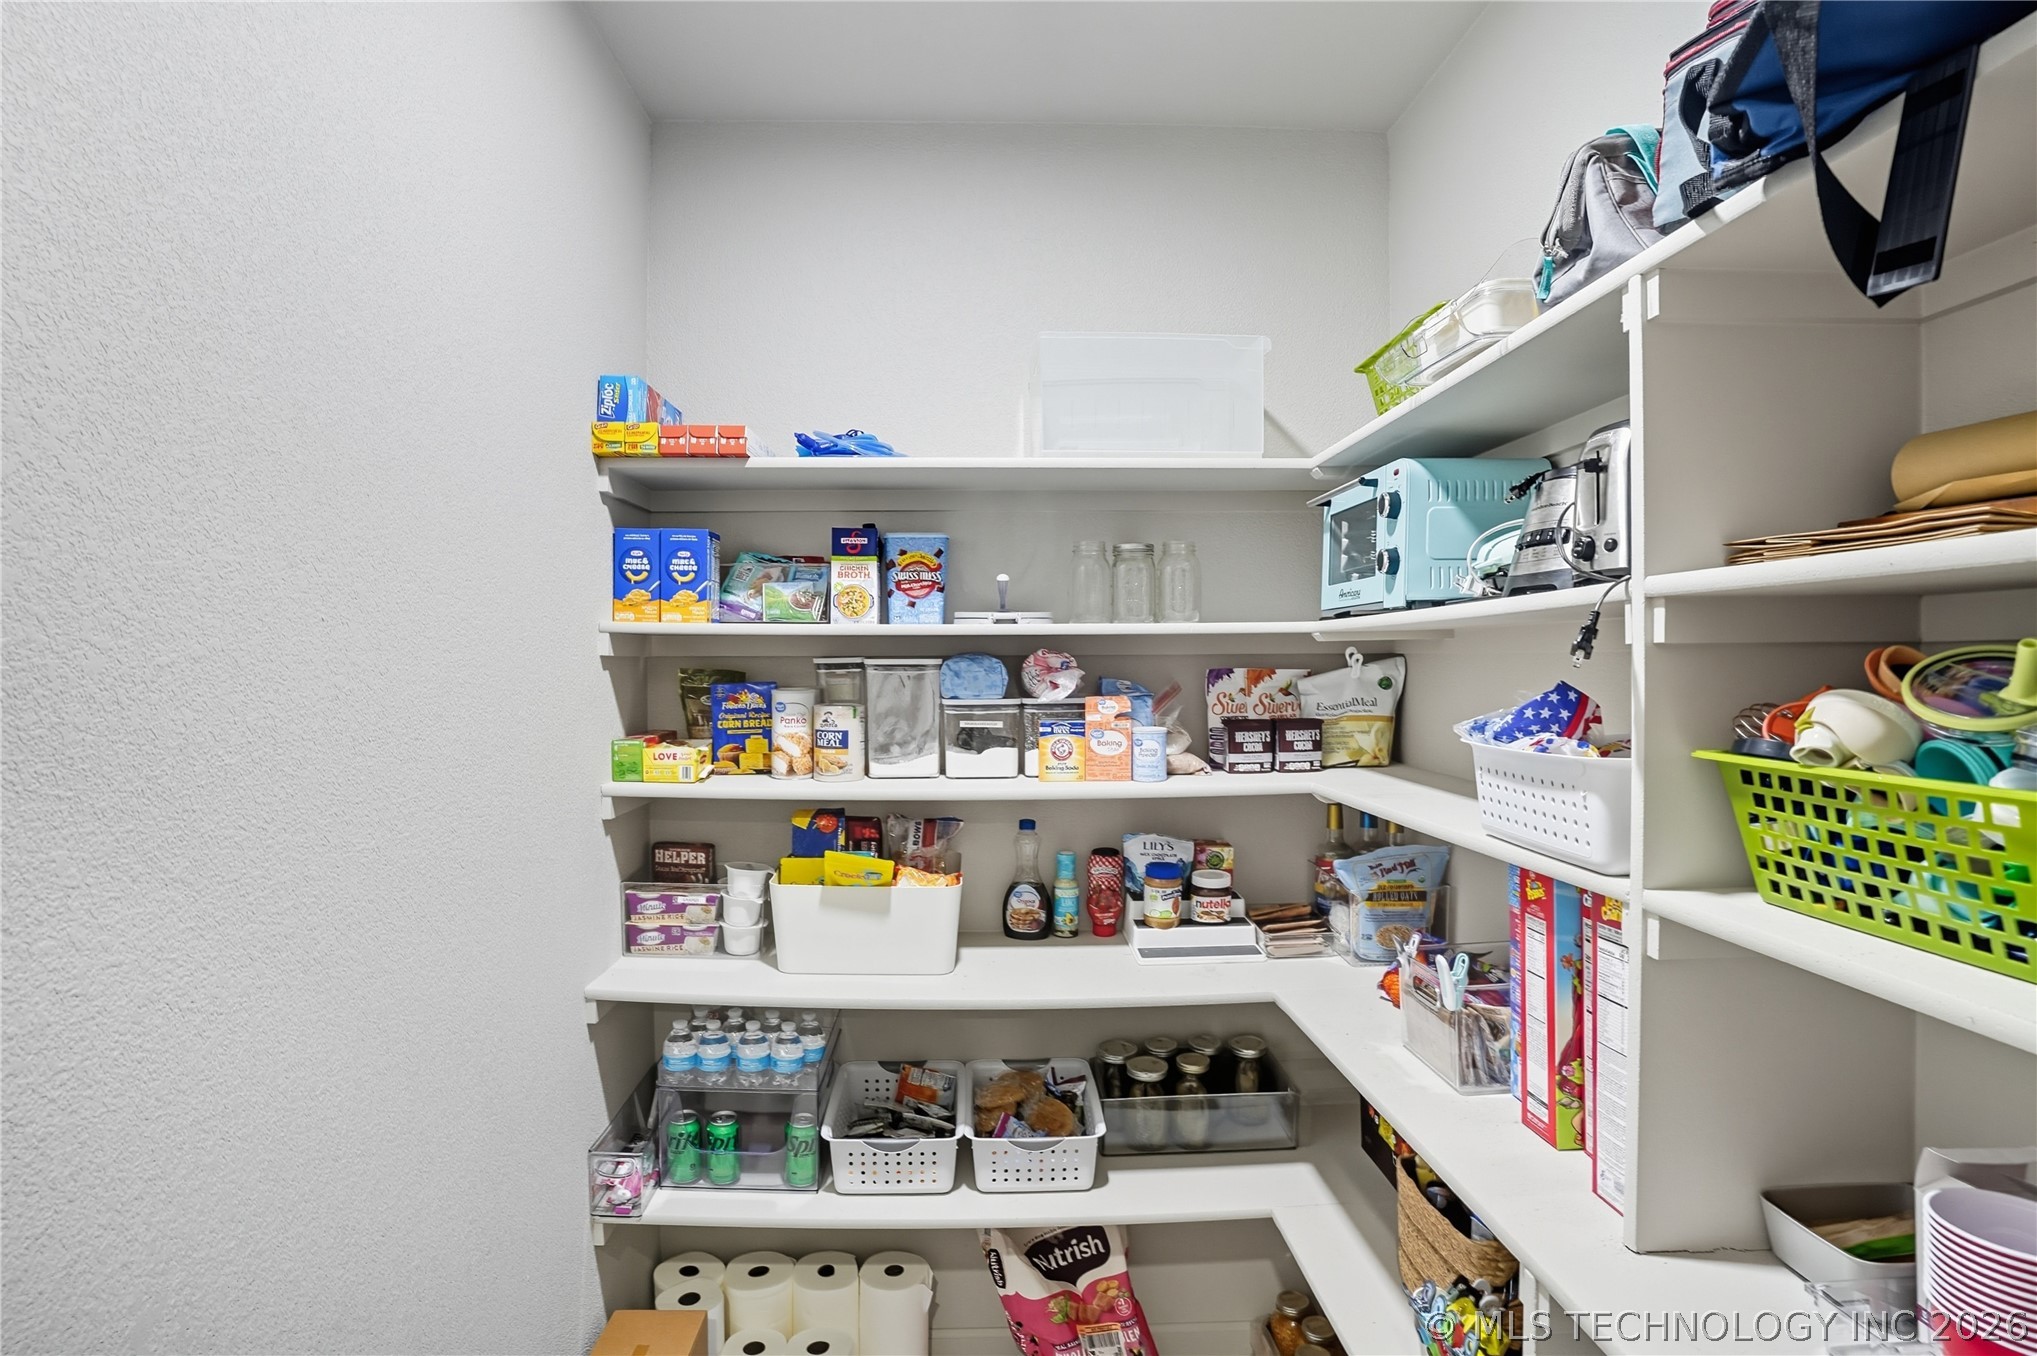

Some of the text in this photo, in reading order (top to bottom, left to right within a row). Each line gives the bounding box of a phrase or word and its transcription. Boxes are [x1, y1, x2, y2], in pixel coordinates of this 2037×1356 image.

[600, 383, 616, 416] Ziploc
[837, 571, 871, 579] BROTH
[817, 731, 843, 740] CORN
[817, 739, 843, 747] MEAL
[1097, 740, 1123, 748] Baking
[653, 752, 678, 760] LOVE
[911, 820, 922, 848] BOWS
[1143, 841, 1174, 852] LILY'S
[655, 850, 706, 864] HELPER
[1196, 898, 1231, 909] nutella
[1032, 1234, 1106, 1271] Nutrish
